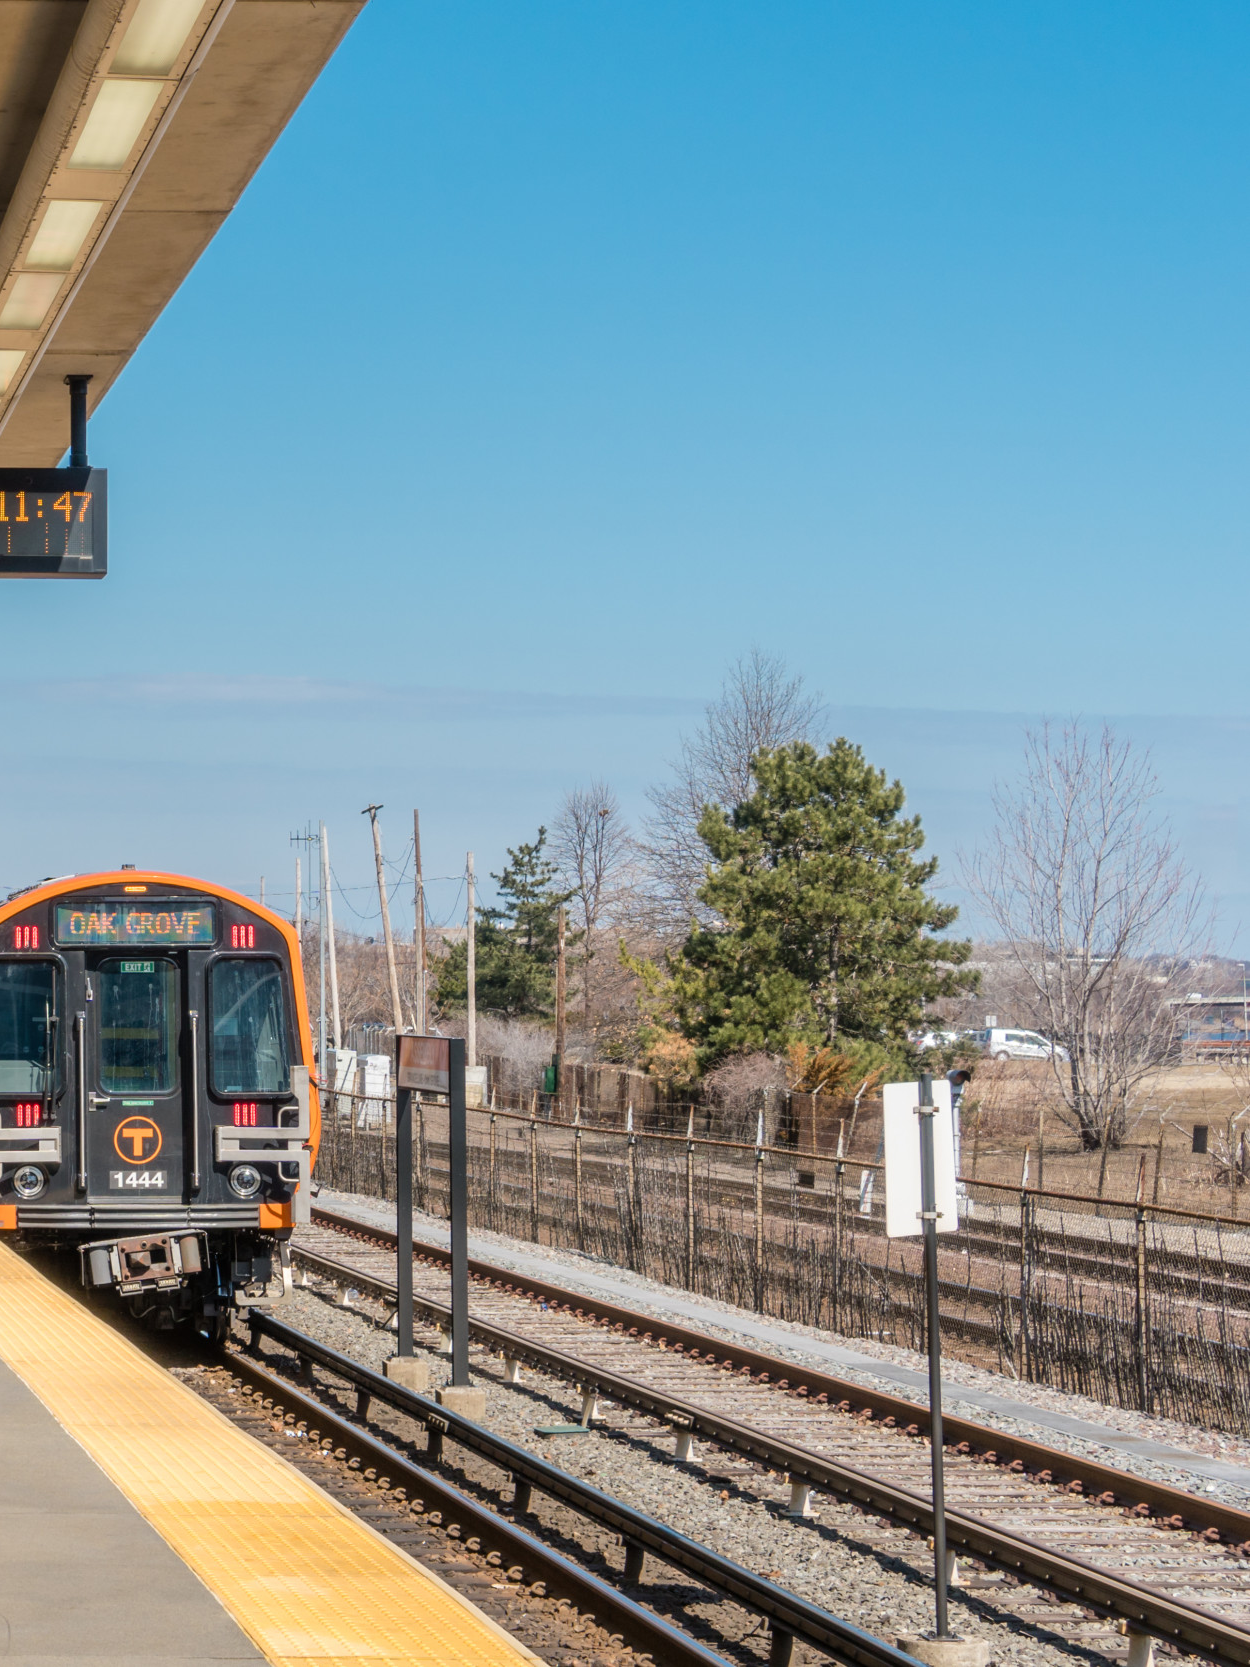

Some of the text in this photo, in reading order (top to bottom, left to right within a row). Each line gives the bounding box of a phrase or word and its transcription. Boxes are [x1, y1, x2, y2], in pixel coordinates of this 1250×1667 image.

[70, 912, 201, 935] OAK GROVE
[125, 963, 142, 971] EXIT
[122, 1128, 154, 1157] T
[113, 1171, 165, 1188] 1444
